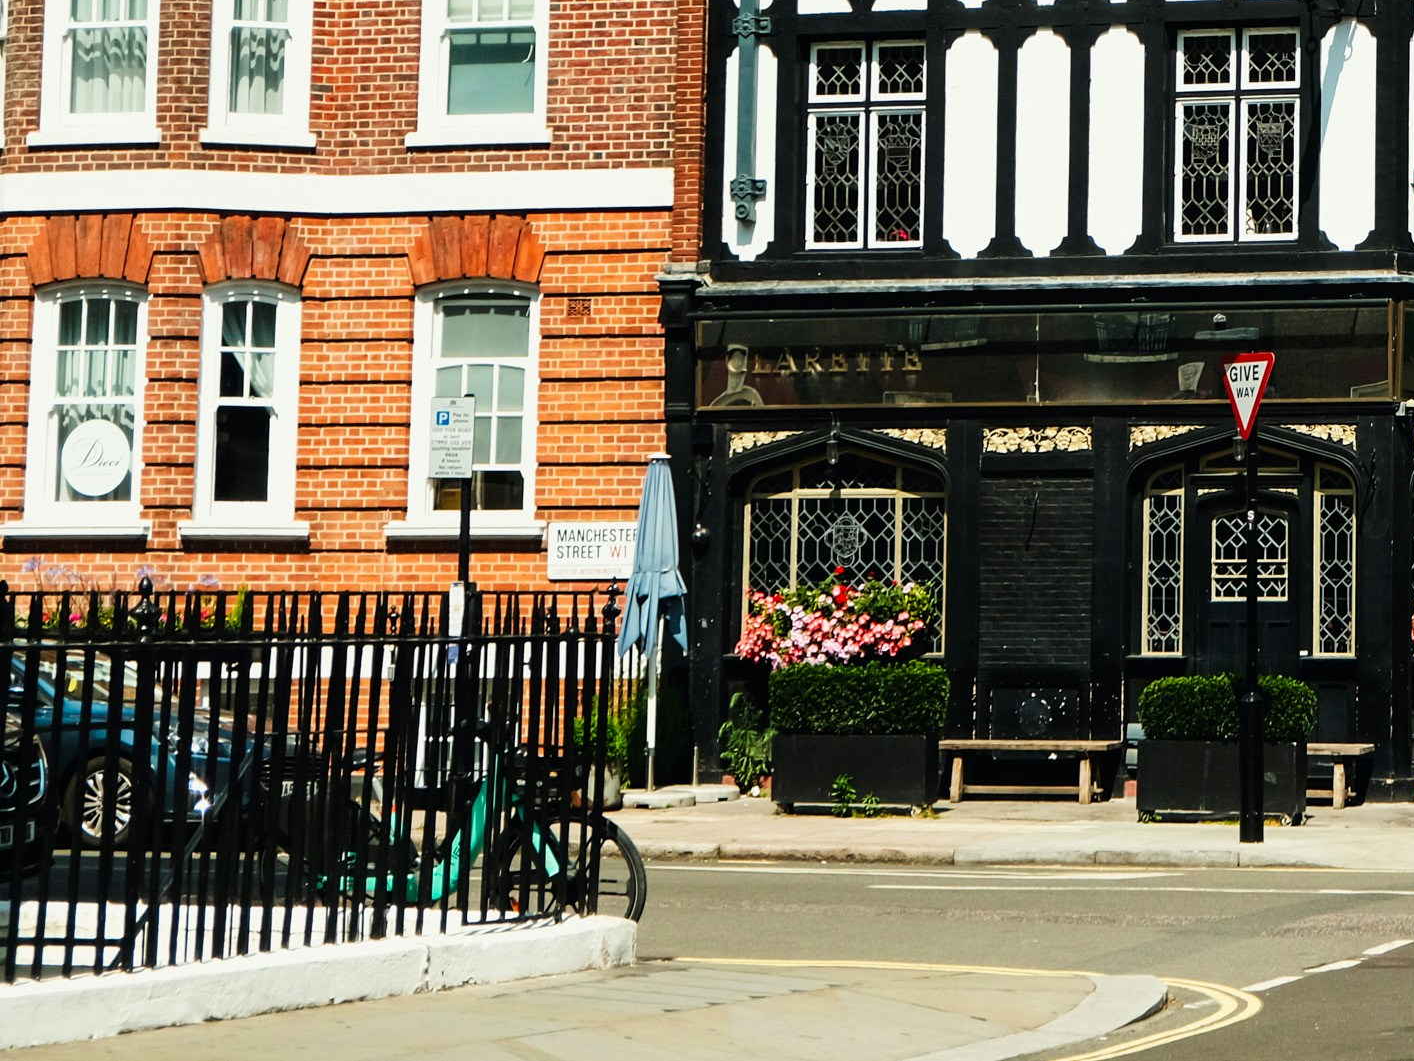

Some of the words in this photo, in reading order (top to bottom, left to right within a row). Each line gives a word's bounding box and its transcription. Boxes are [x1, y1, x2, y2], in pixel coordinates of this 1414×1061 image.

[1229, 365, 1260, 383] GIVE
[1236, 387, 1255, 399] WAY
[556, 545, 602, 559] STREET
[609, 545, 627, 558] W1
